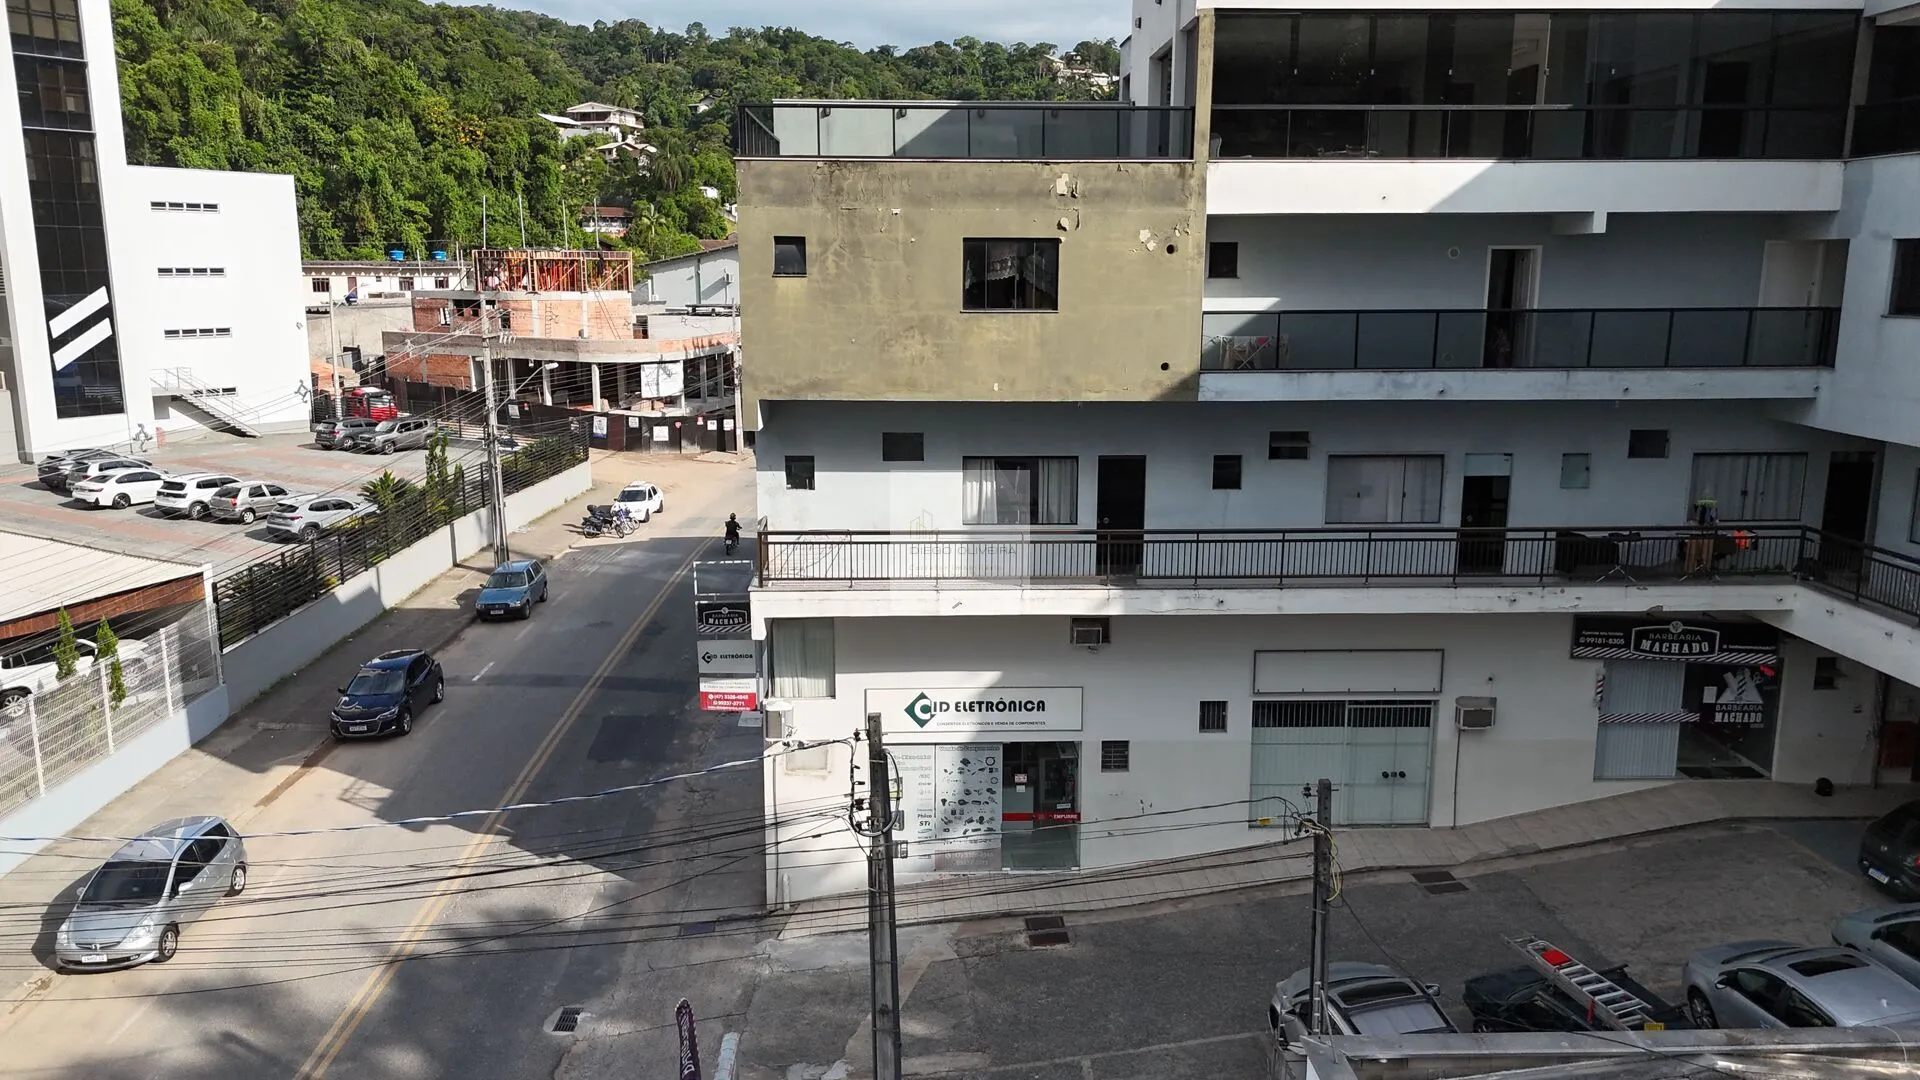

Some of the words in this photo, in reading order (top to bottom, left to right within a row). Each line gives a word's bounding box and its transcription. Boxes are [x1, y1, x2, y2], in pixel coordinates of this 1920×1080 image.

[1640, 640, 1709, 653] MACHADO
[955, 698, 1046, 712] ELETRÔNICA
[1714, 712, 1762, 722] MACHADO
